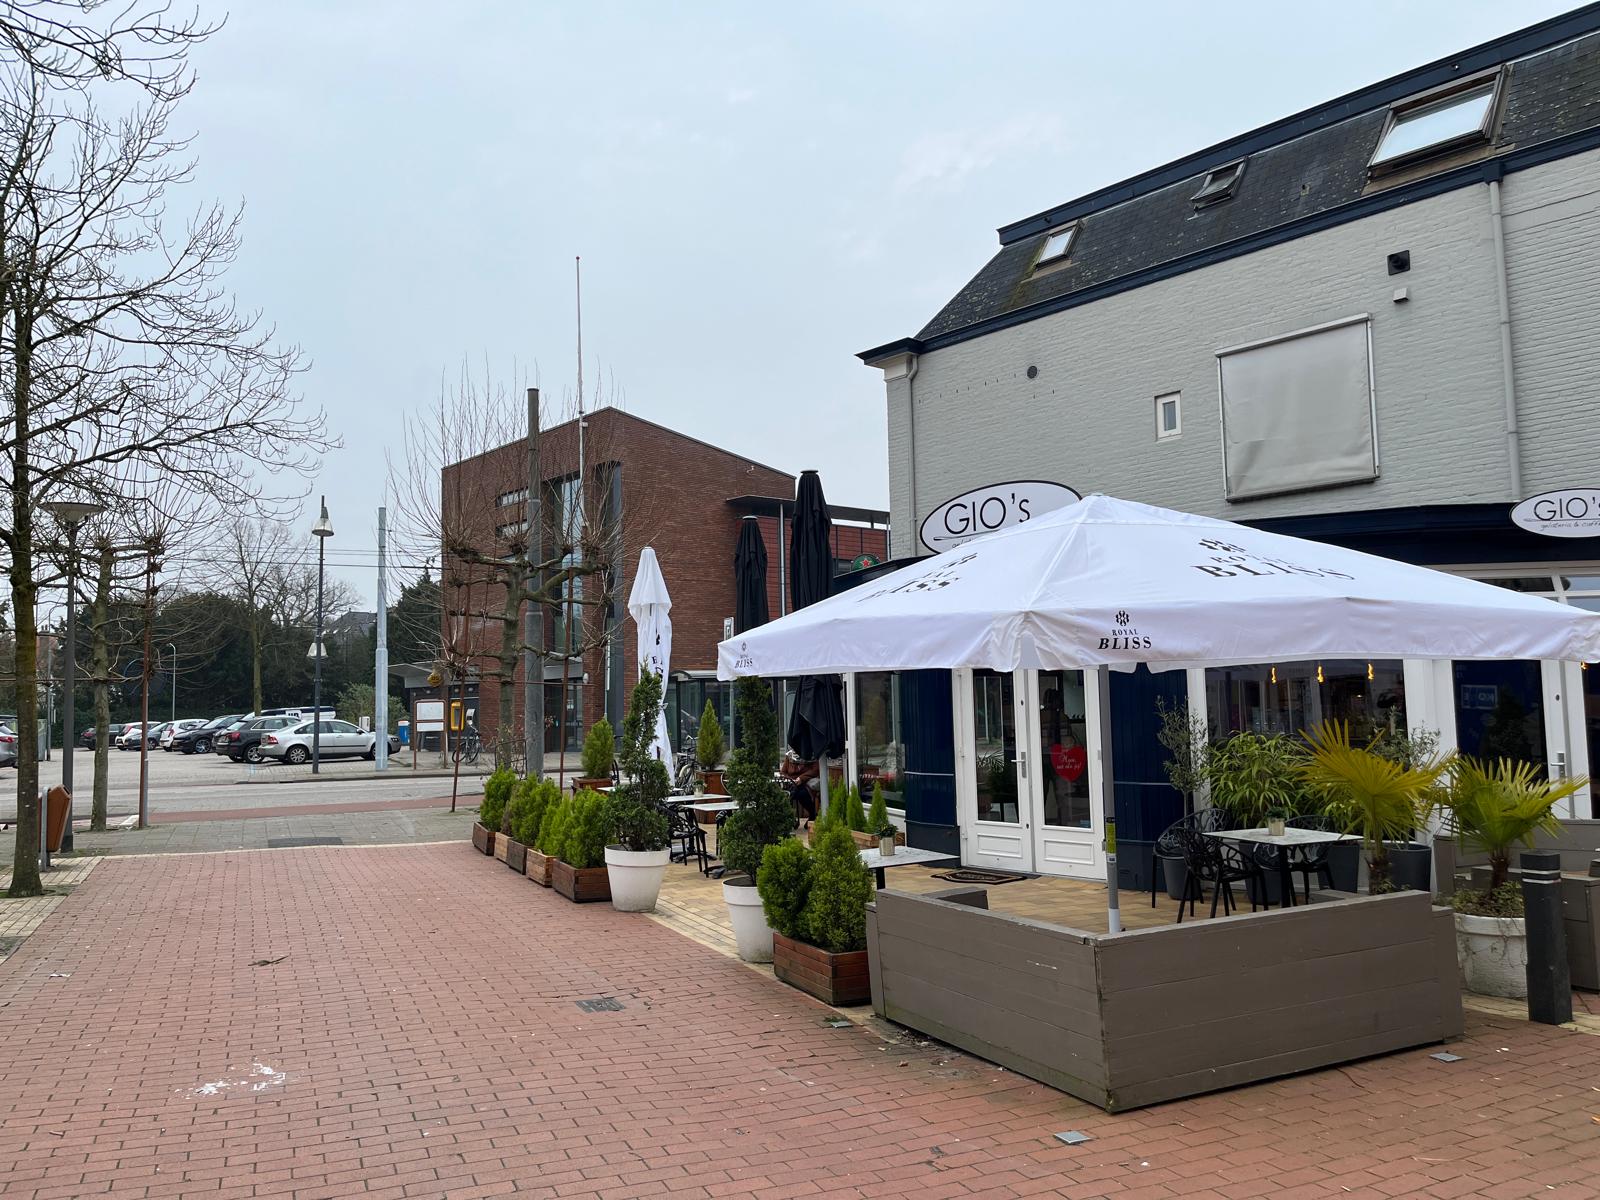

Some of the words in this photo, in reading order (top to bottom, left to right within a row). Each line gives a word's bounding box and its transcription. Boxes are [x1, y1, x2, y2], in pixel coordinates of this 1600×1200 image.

[944, 493, 1031, 535] GIO's
[1534, 496, 1600, 521] GIO'
[1190, 561, 1355, 581] BLISS
[1111, 628, 1139, 637] ROYAL
[1097, 636, 1152, 650] BLISS
